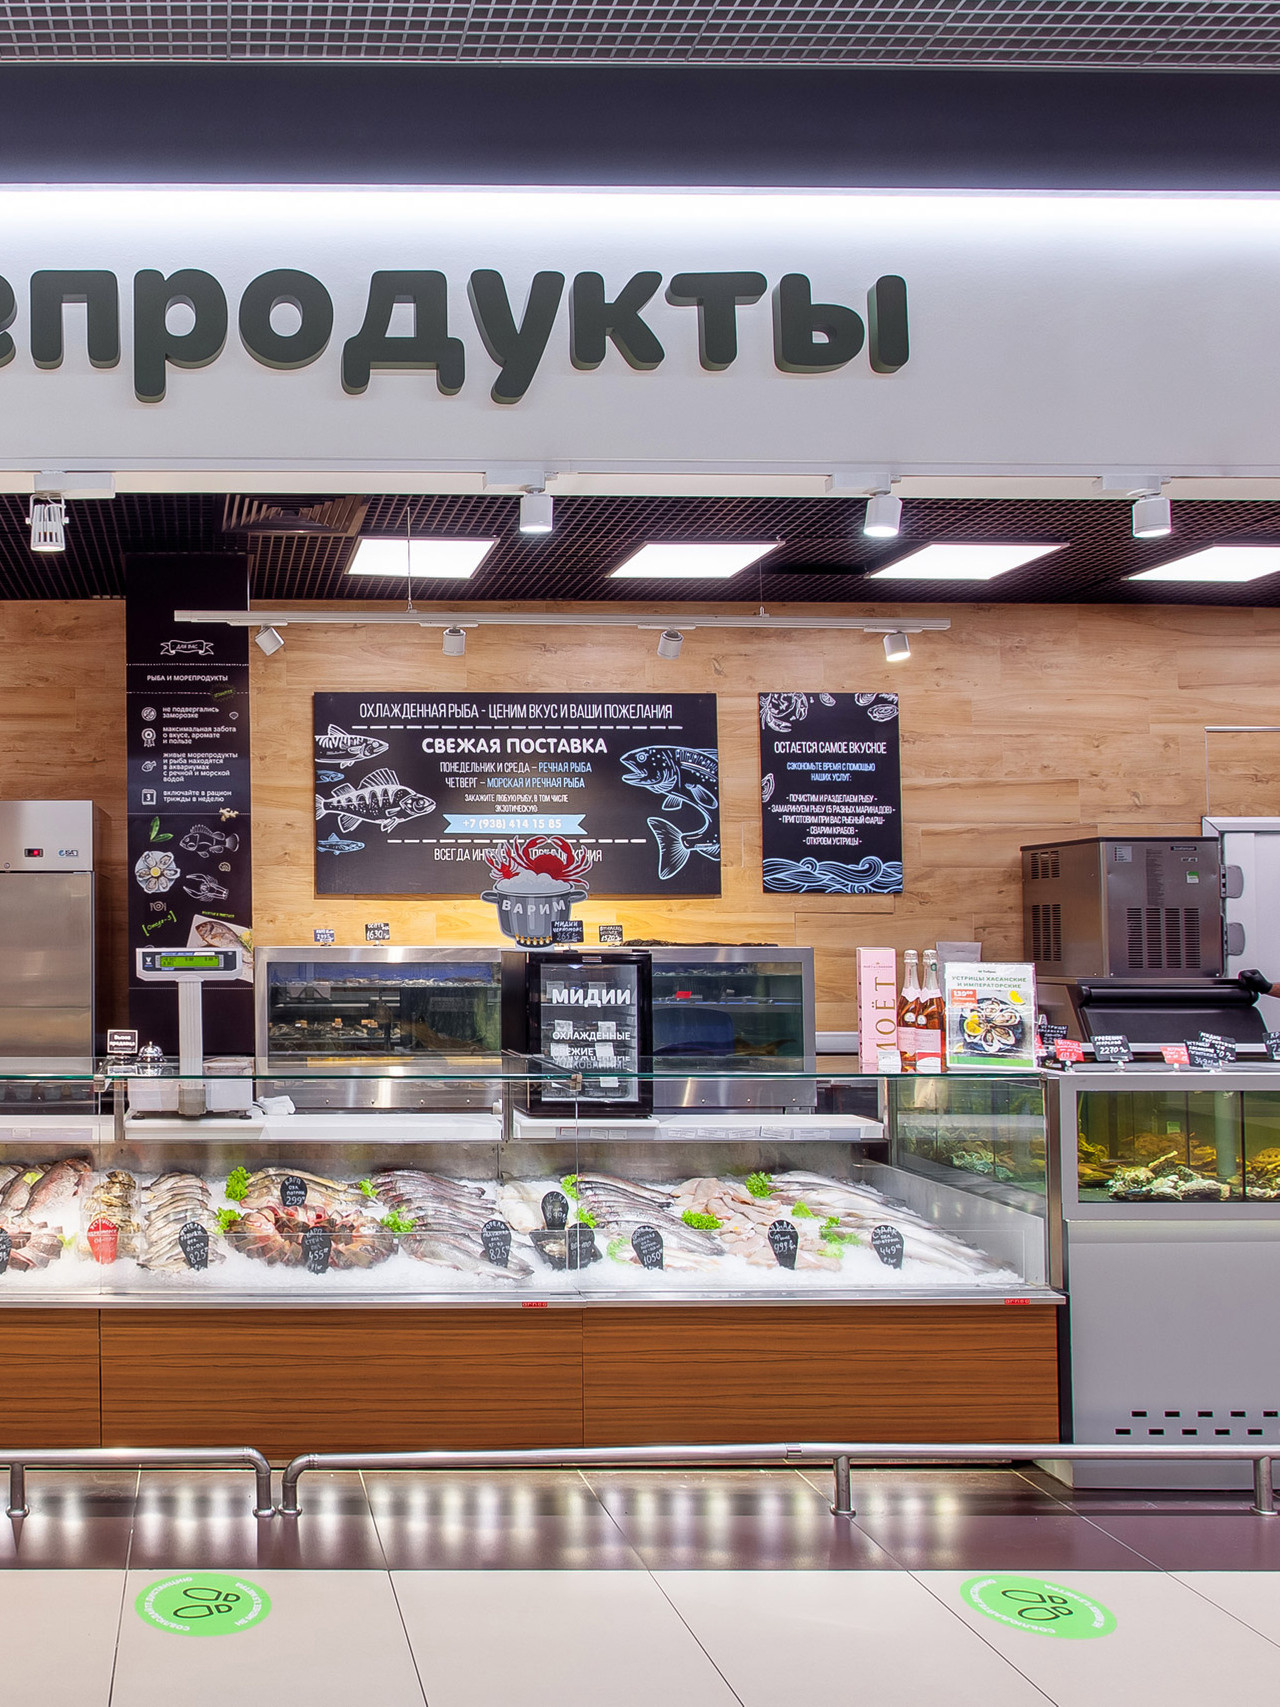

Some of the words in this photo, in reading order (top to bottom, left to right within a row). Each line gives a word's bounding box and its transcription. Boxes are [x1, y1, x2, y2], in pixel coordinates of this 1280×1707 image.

[173, 674, 228, 682] МОРЕПРОДУКТЫ
[359, 703, 447, 719] ОХЛАЖДЕННАЯ
[448, 704, 478, 719] РЫБА
[488, 704, 527, 720] ЦЕНИМ
[528, 704, 557, 719] ВКУС
[560, 704, 567, 719] И
[570, 704, 603, 719] ВАШИ
[604, 704, 673, 719] ПОЖЕЛАНИЯ
[421, 737, 502, 753] СВЕЖАЯ
[507, 737, 607, 754] ПОСТАВКА
[774, 741, 818, 753] ОСТАЕТСЯ
[818, 742, 848, 753] САМОЕ
[849, 742, 887, 754] ВКУСНОЕ
[440, 761, 496, 774] ПОНЕДЕЛЬНИК
[497, 762, 504, 773] И
[504, 762, 531, 774] СРЕДА
[538, 762, 569, 774] РЕЧНАЯ
[570, 762, 592, 774] РЫБА
[787, 762, 822, 770] СЭКОНОМЬТЕ
[822, 762, 841, 770] ВРЕМЯ
[846, 763, 876, 771] ПОМОЩЬЮ
[811, 773, 832, 781] НАШИХ
[445, 777, 477, 789] ЧЕТВЕРГ
[486, 777, 524, 789] МОРСКАЯ
[525, 777, 530, 788] И
[532, 777, 562, 789] РЕЧНАЯ
[563, 777, 585, 789] РЫБА
[465, 794, 495, 802] ЗАКАЖИТЕ
[538, 794, 550, 802] ТОМ
[551, 794, 568, 802] ЧИСЛЕ
[789, 794, 819, 802] ПОЧИСТИМ
[823, 795, 858, 803] РАЗДЕЛАЕМ
[810, 805, 825, 813] РЫБУ
[782, 815, 818, 823] ПРИГОТОВИМ
[463, 820, 476, 829] +7
[479, 819, 506, 830] (938)
[508, 819, 529, 829] 414
[533, 819, 545, 829] 15
[548, 819, 562, 829] 85
[810, 826, 833, 834] СВАРИМ
[806, 837, 832, 845] ОТКРОЕМ
[832, 837, 859, 845] УСТРИЦЫ
[434, 849, 470, 861] ВСЕГДА
[502, 899, 566, 916] ВАРИМ
[552, 989, 631, 1008] МИДИИ
[552, 1032, 631, 1041] ОХЛАЖДЕННЫЕ
